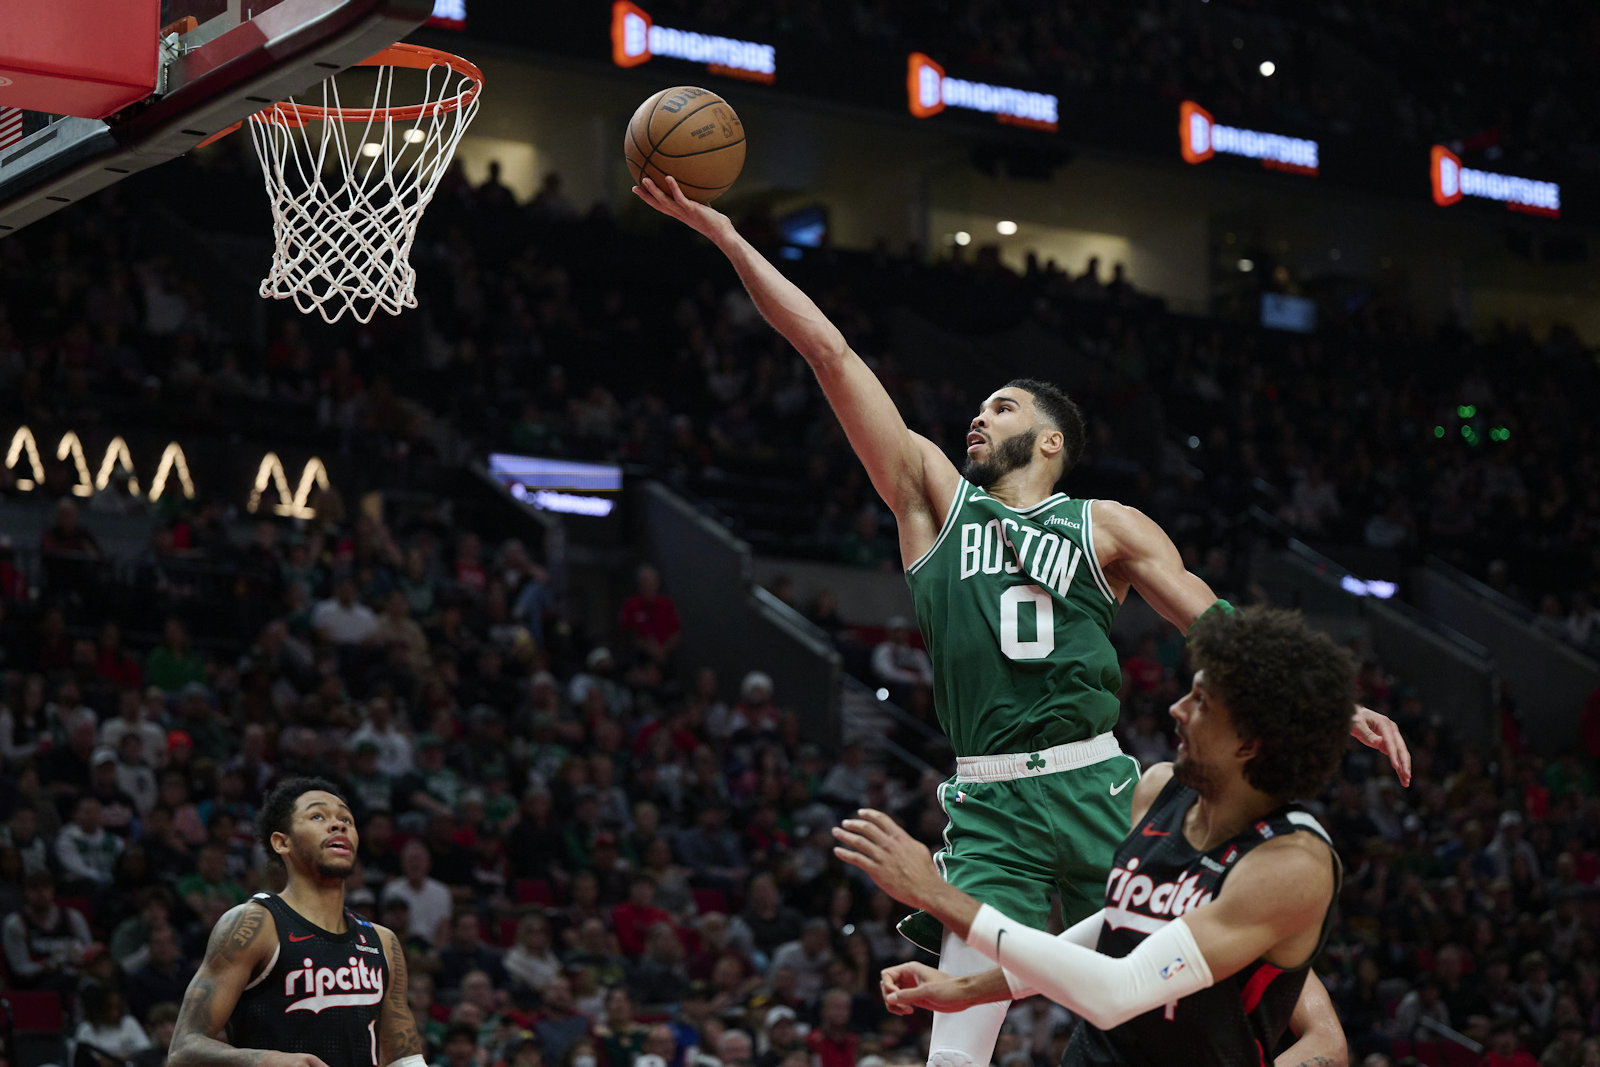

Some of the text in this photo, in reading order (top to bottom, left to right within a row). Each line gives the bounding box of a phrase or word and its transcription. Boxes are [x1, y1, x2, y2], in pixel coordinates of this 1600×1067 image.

[648, 24, 776, 74] BRIGHTSIDE
[941, 76, 1059, 123] BRIGHTSIDE
[1211, 123, 1319, 168] BRIGHTSIDE
[1460, 167, 1561, 210] BRIGHTSIDE
[1043, 514, 1081, 530] Amica
[960, 517, 1083, 598] BOSTON
[1000, 584, 1055, 660] 0
[285, 956, 384, 1003] ripcity
